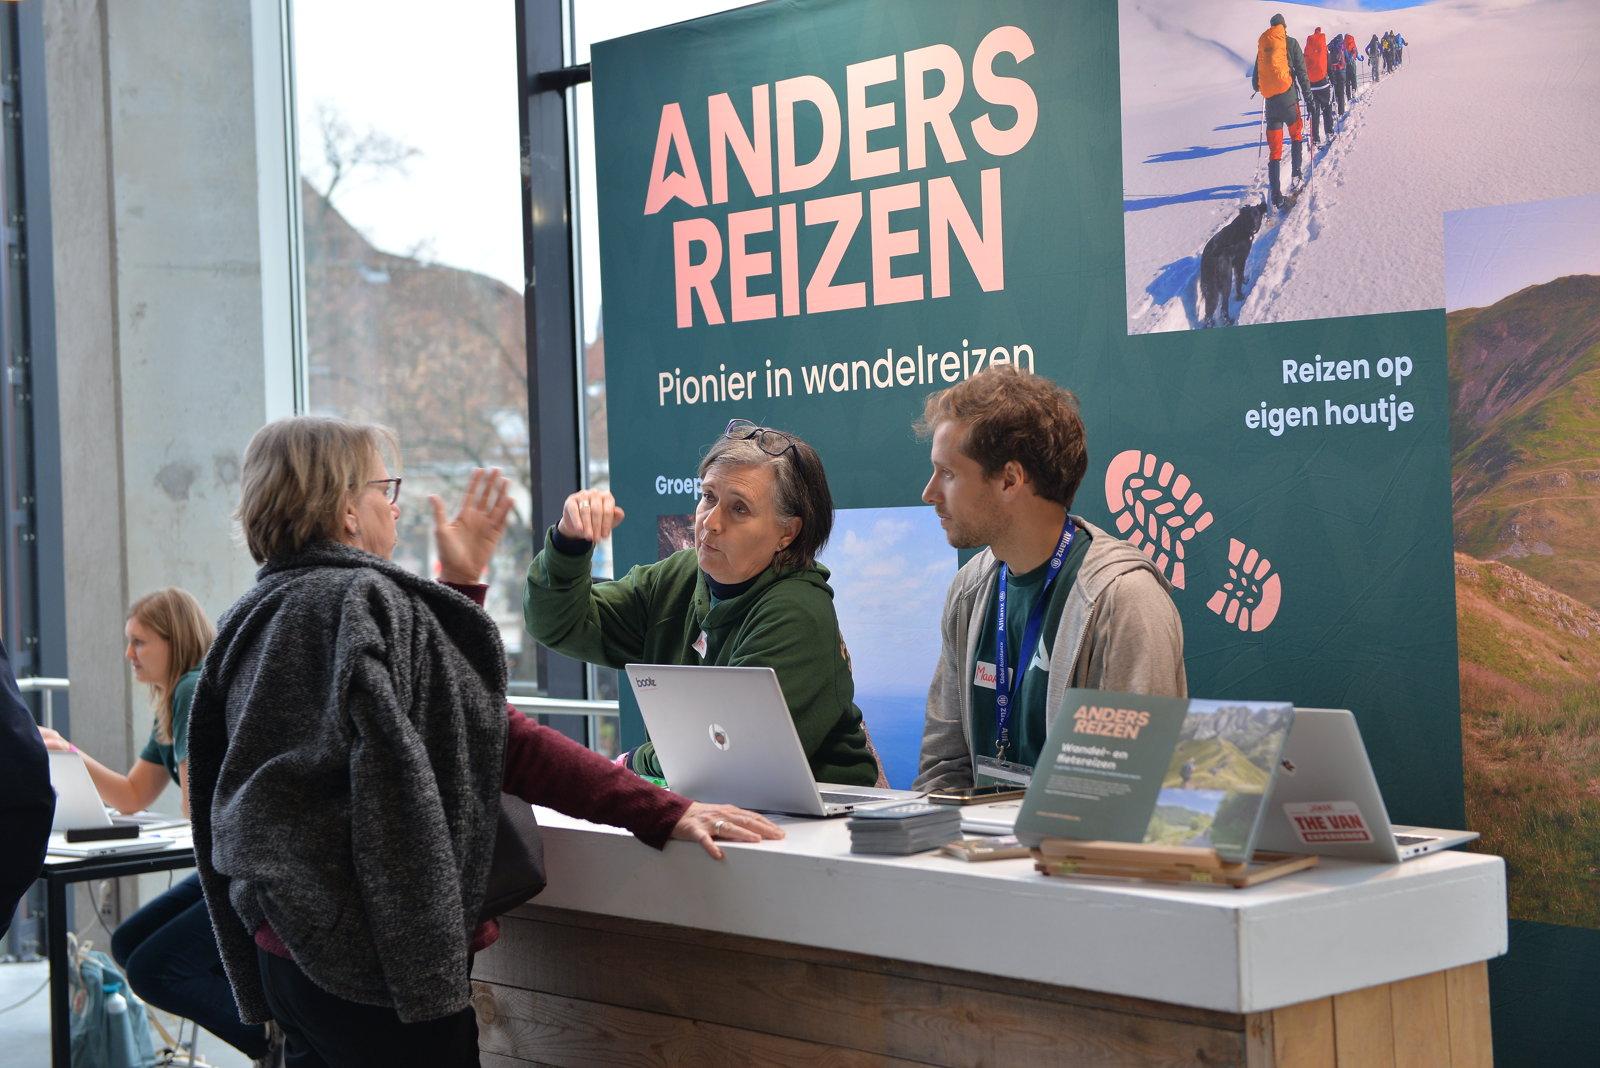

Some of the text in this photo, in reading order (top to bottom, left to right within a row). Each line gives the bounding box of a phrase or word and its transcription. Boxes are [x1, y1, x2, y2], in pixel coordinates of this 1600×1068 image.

[643, 25, 1039, 215] ANDERS
[672, 167, 1005, 328] REIZEN
[658, 339, 1035, 406] Pionier in wandelreizen
[1282, 354, 1413, 386] Reizen op
[1245, 393, 1415, 437] eigen houtje
[1055, 530, 1072, 558] Allianz
[1072, 719, 1141, 740] REIZEN
[1073, 704, 1151, 727] ANDERS
[1293, 814, 1364, 830] THE VAN
